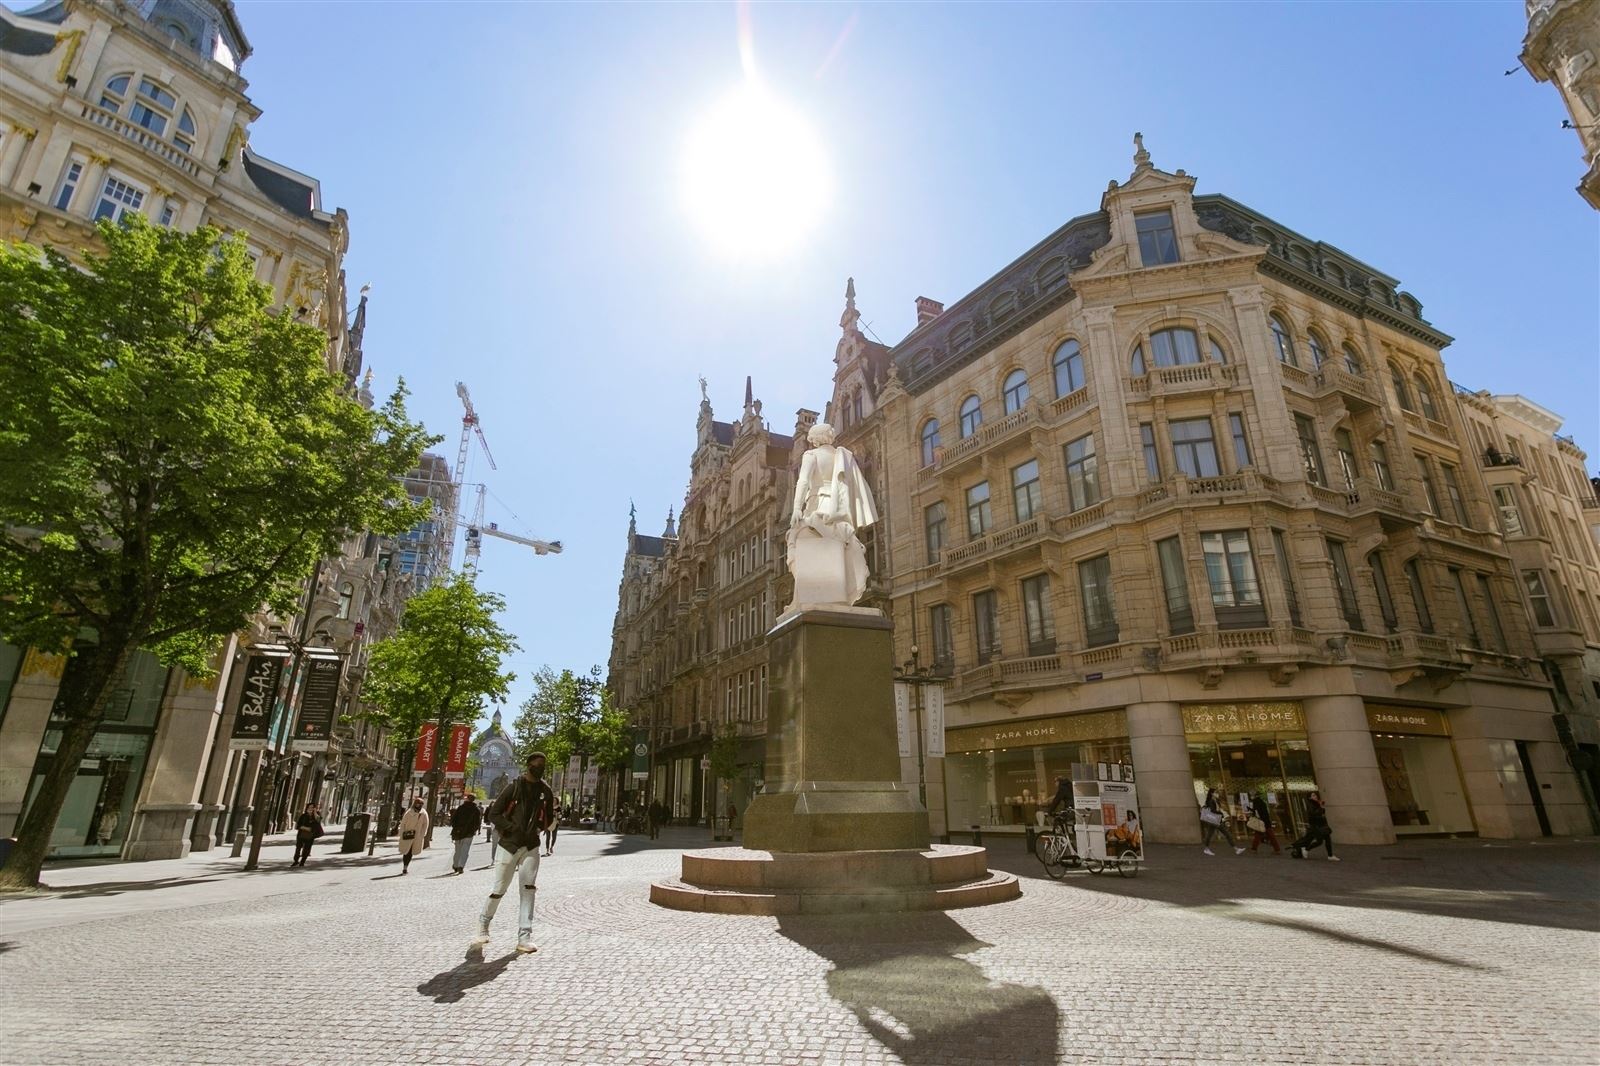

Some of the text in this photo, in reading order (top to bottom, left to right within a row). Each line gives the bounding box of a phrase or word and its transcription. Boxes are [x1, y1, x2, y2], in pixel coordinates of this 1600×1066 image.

[242, 661, 272, 716] Bel-Air
[1195, 712, 1293, 723] ZARA HOME
[1376, 714, 1427, 725] ZARA HOME
[995, 727, 1056, 740] ZARA HOME
